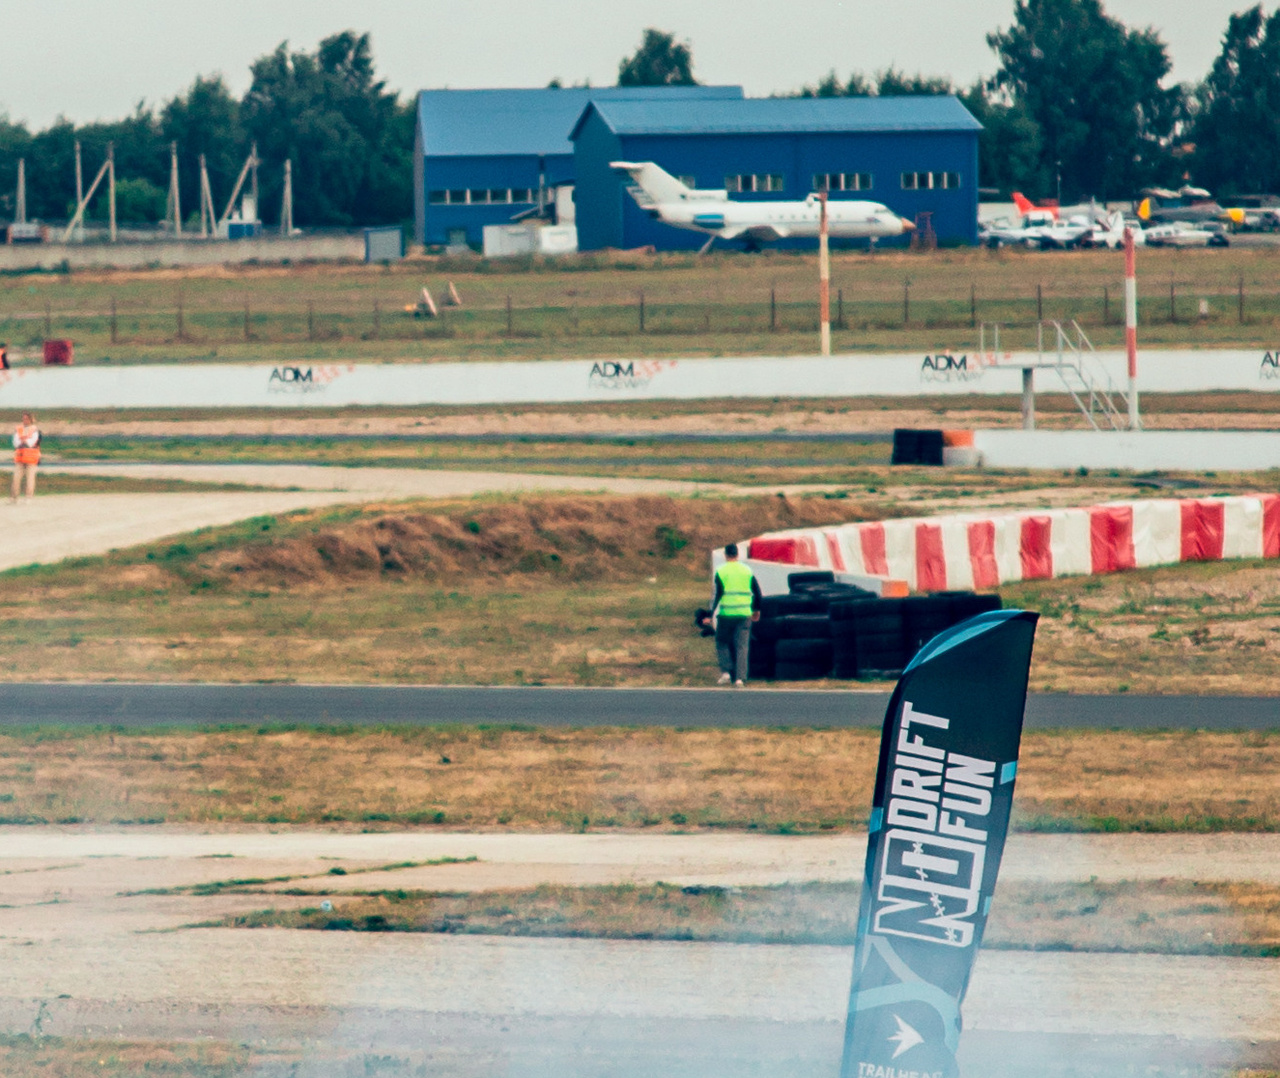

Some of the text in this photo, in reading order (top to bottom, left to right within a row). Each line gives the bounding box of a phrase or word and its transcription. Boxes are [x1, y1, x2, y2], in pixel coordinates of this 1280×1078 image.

[590, 362, 634, 378] ADM
[921, 354, 967, 371] ADM
[269, 366, 313, 383] ADM
[887, 701, 950, 832] DRIFT
[939, 752, 996, 841] FUN
